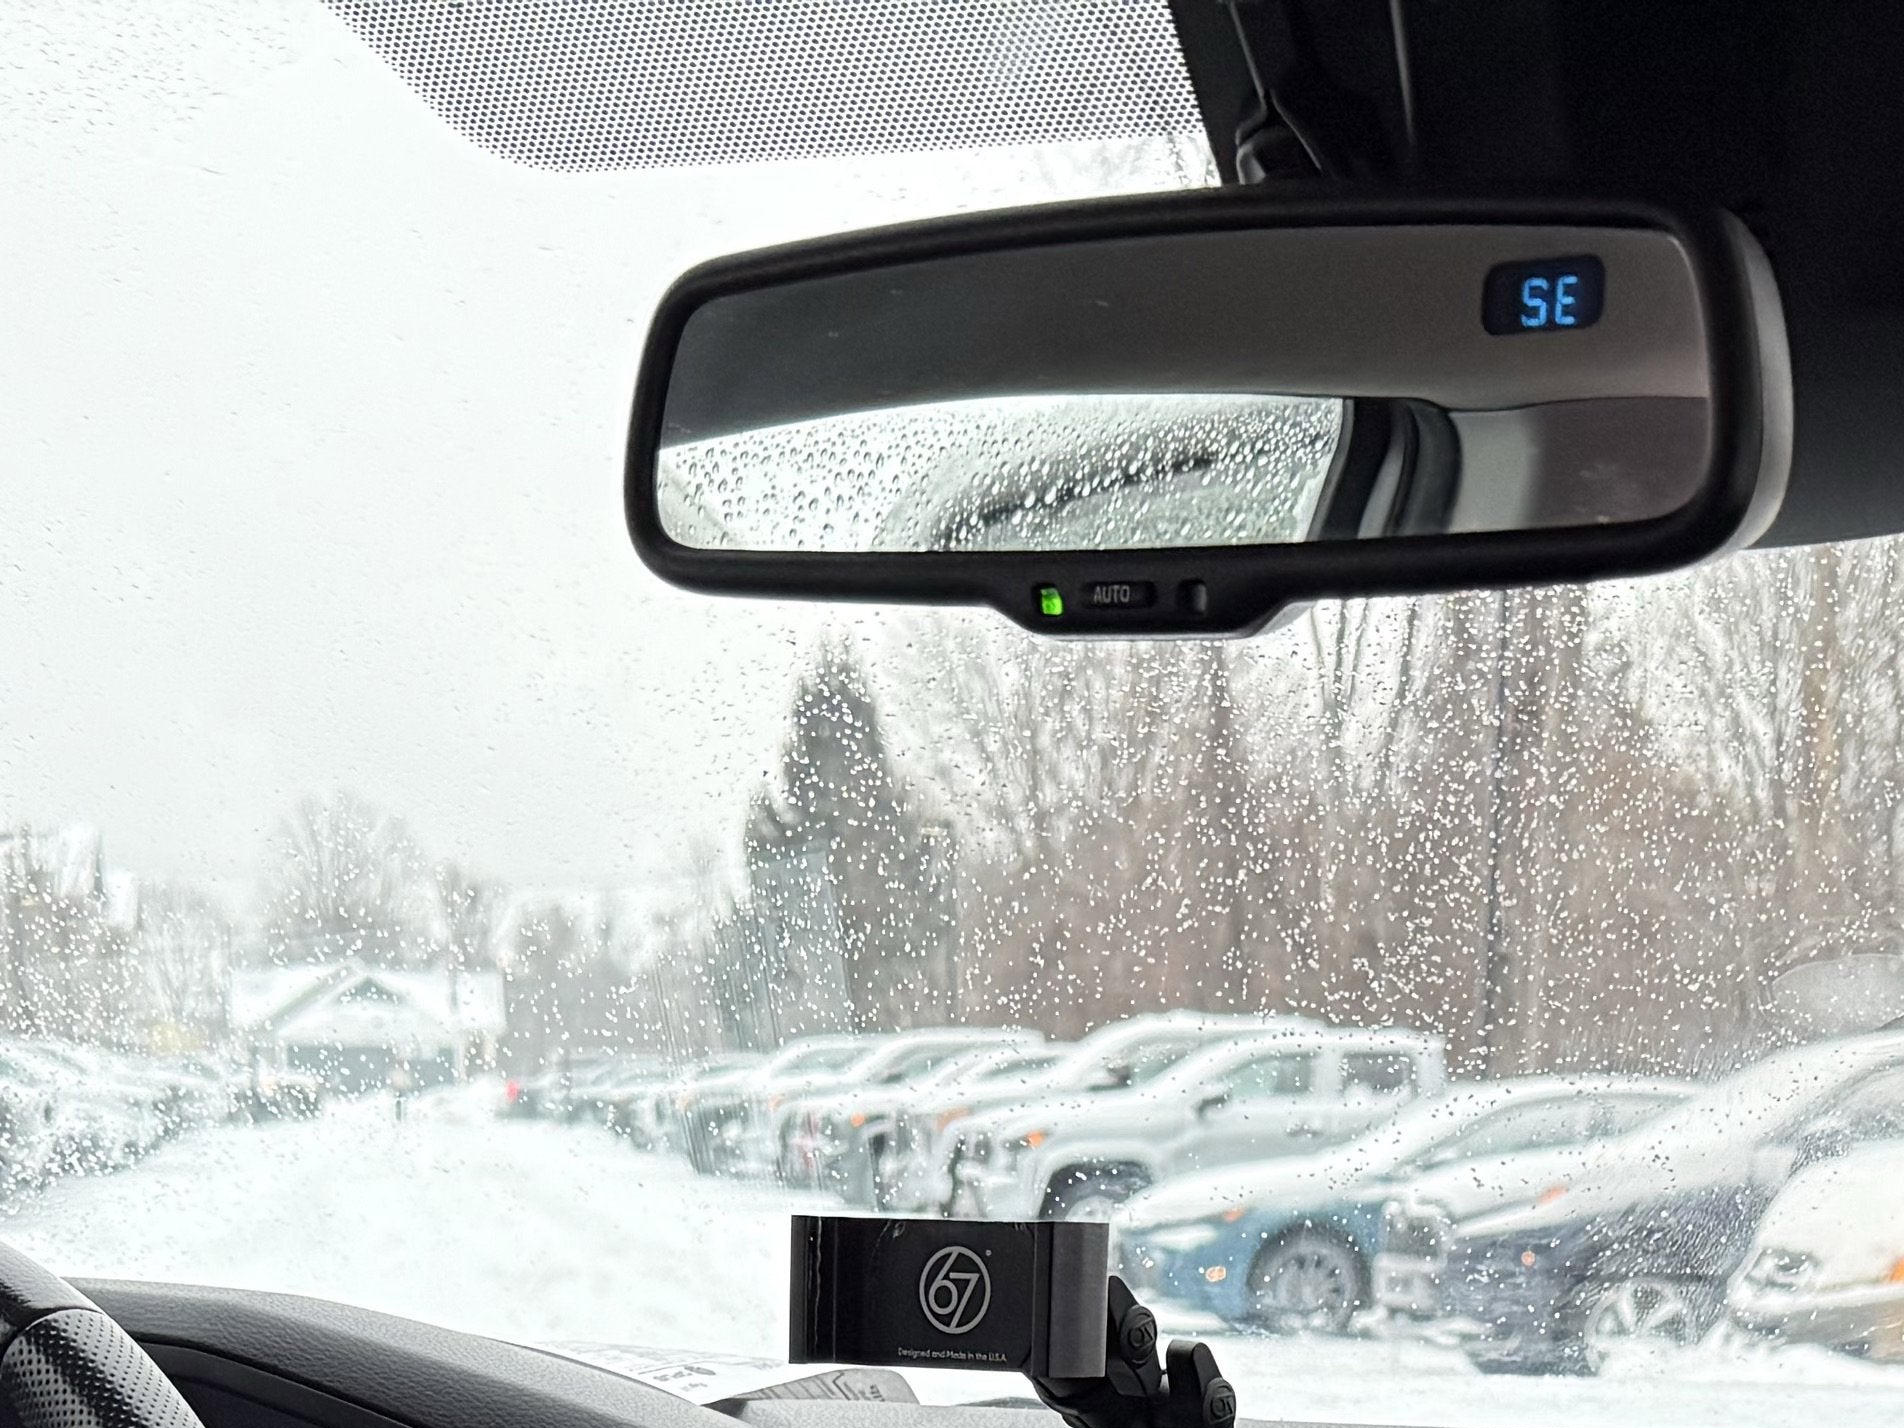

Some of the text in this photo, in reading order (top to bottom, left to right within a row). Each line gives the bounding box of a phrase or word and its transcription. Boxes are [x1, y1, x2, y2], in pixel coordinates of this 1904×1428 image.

[1520, 275, 1580, 328] SE
[1092, 584, 1131, 605] AUTO
[926, 1247, 982, 1331] 67
[897, 1347, 931, 1360] Designed
[931, 1350, 946, 1359] and
[946, 1350, 967, 1360] Made
[968, 1351, 975, 1360] in
[976, 1351, 988, 1361] the
